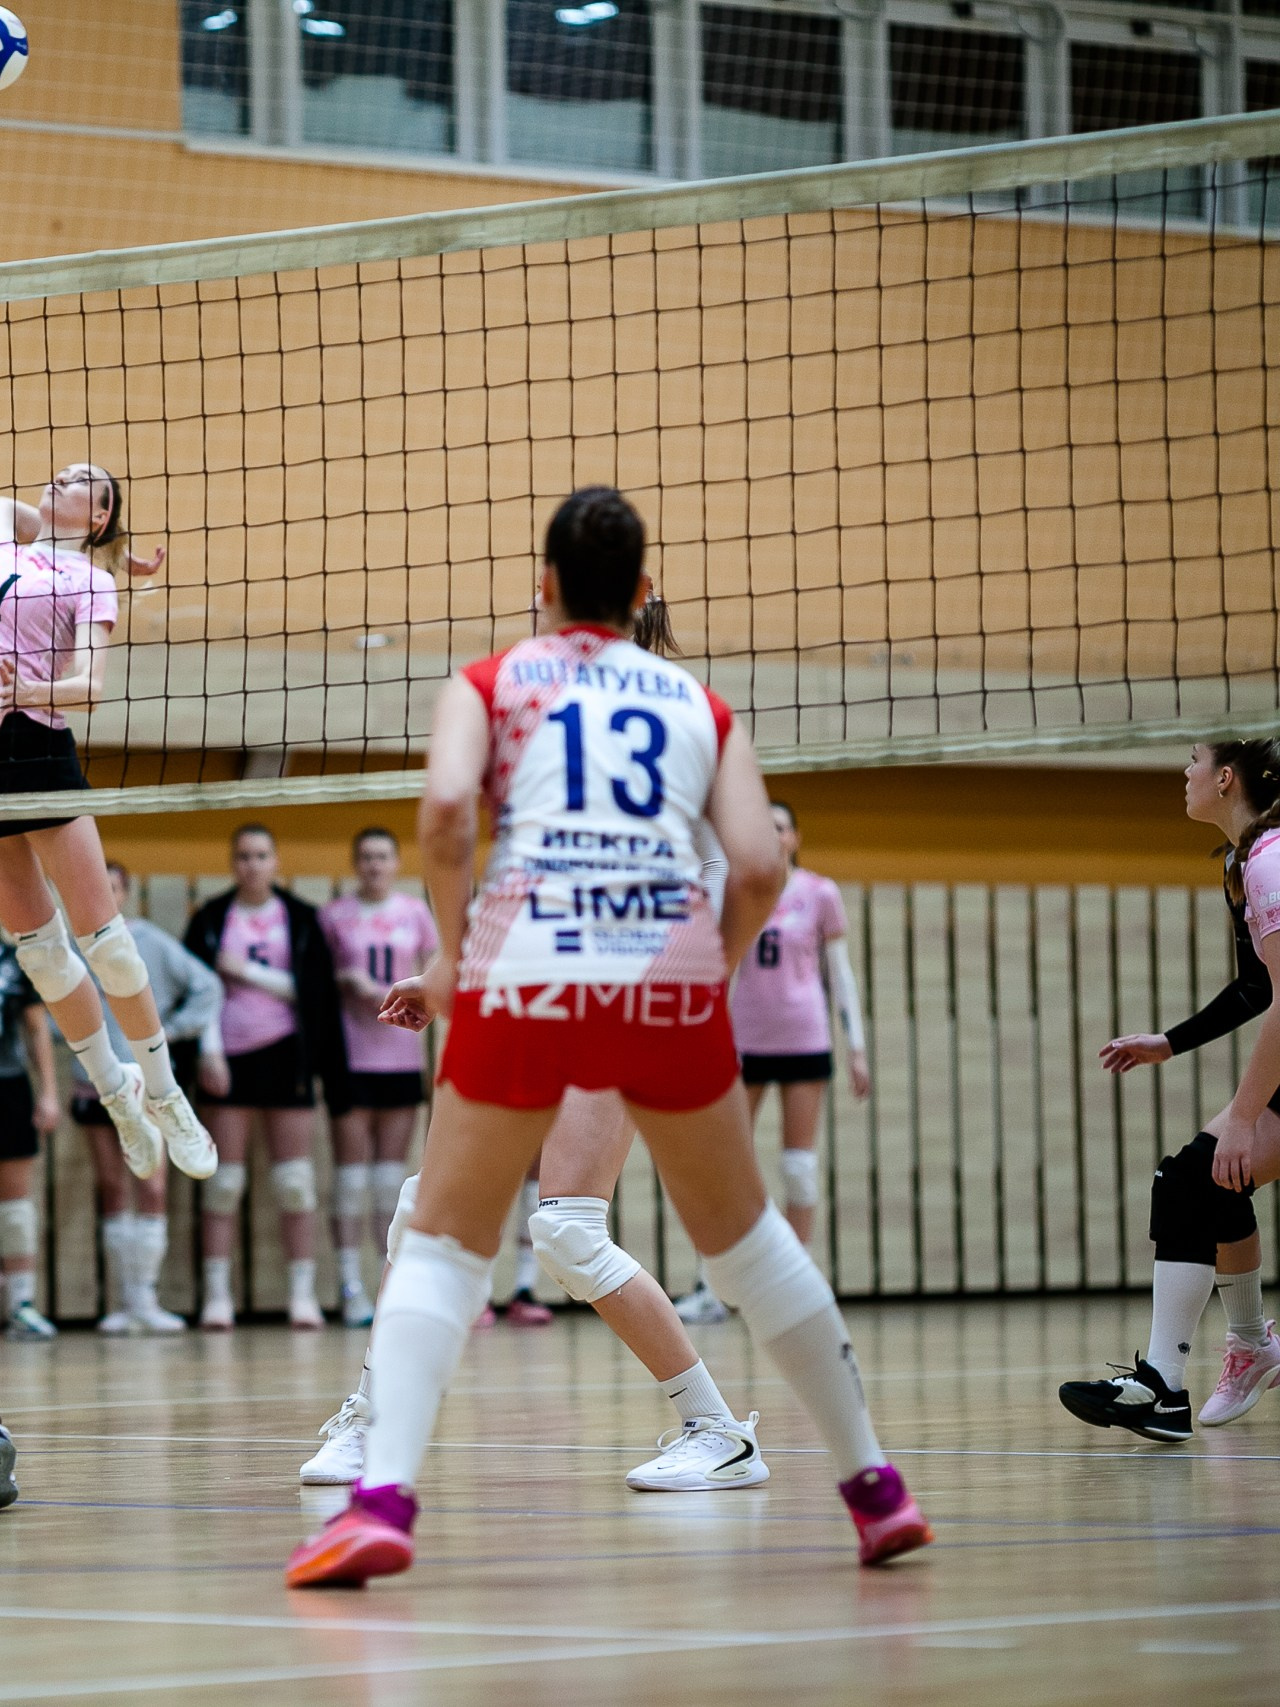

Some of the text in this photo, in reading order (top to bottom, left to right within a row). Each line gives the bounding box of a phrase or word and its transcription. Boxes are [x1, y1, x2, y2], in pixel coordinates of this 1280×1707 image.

[549, 702, 668, 817] 13
[542, 829, 675, 858] ИСКРА
[529, 883, 690, 921] LIME
[757, 928, 781, 969] 6
